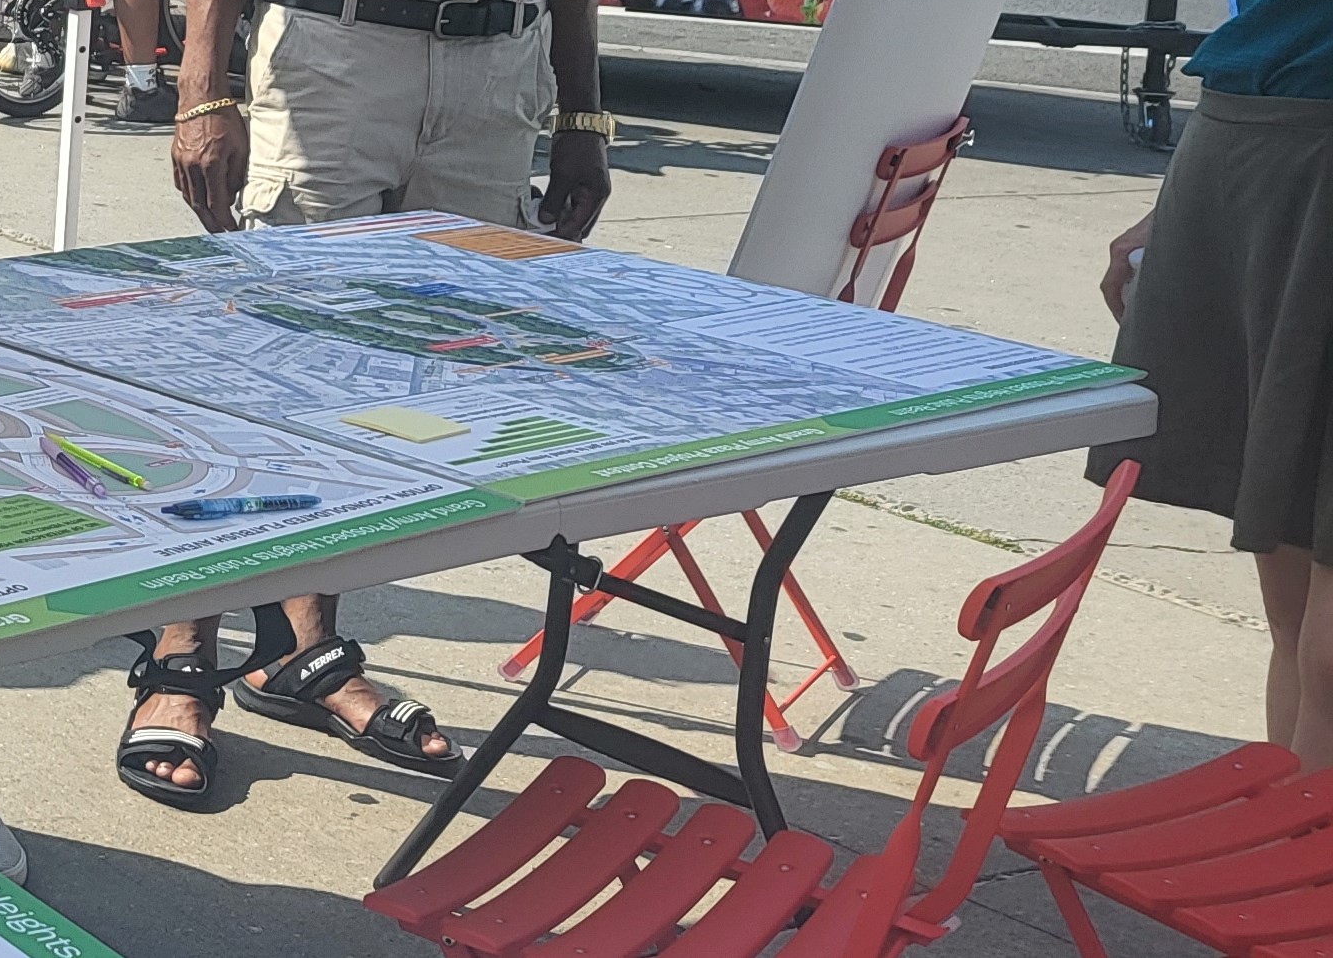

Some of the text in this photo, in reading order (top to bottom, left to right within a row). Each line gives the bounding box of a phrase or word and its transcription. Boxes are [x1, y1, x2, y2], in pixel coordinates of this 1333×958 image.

[590, 427, 825, 478] Grand Army Plaza Project Context
[392, 483, 444, 500] OPTION
[282, 498, 380, 526] CONSOLIDATED
[138, 499, 486, 590] Grand Army/Prospect Heights Public Realm
[210, 521, 285, 543] FLATBUSH
[152, 539, 214, 557] AVENUE
[307, 646, 345, 674] TERREX
